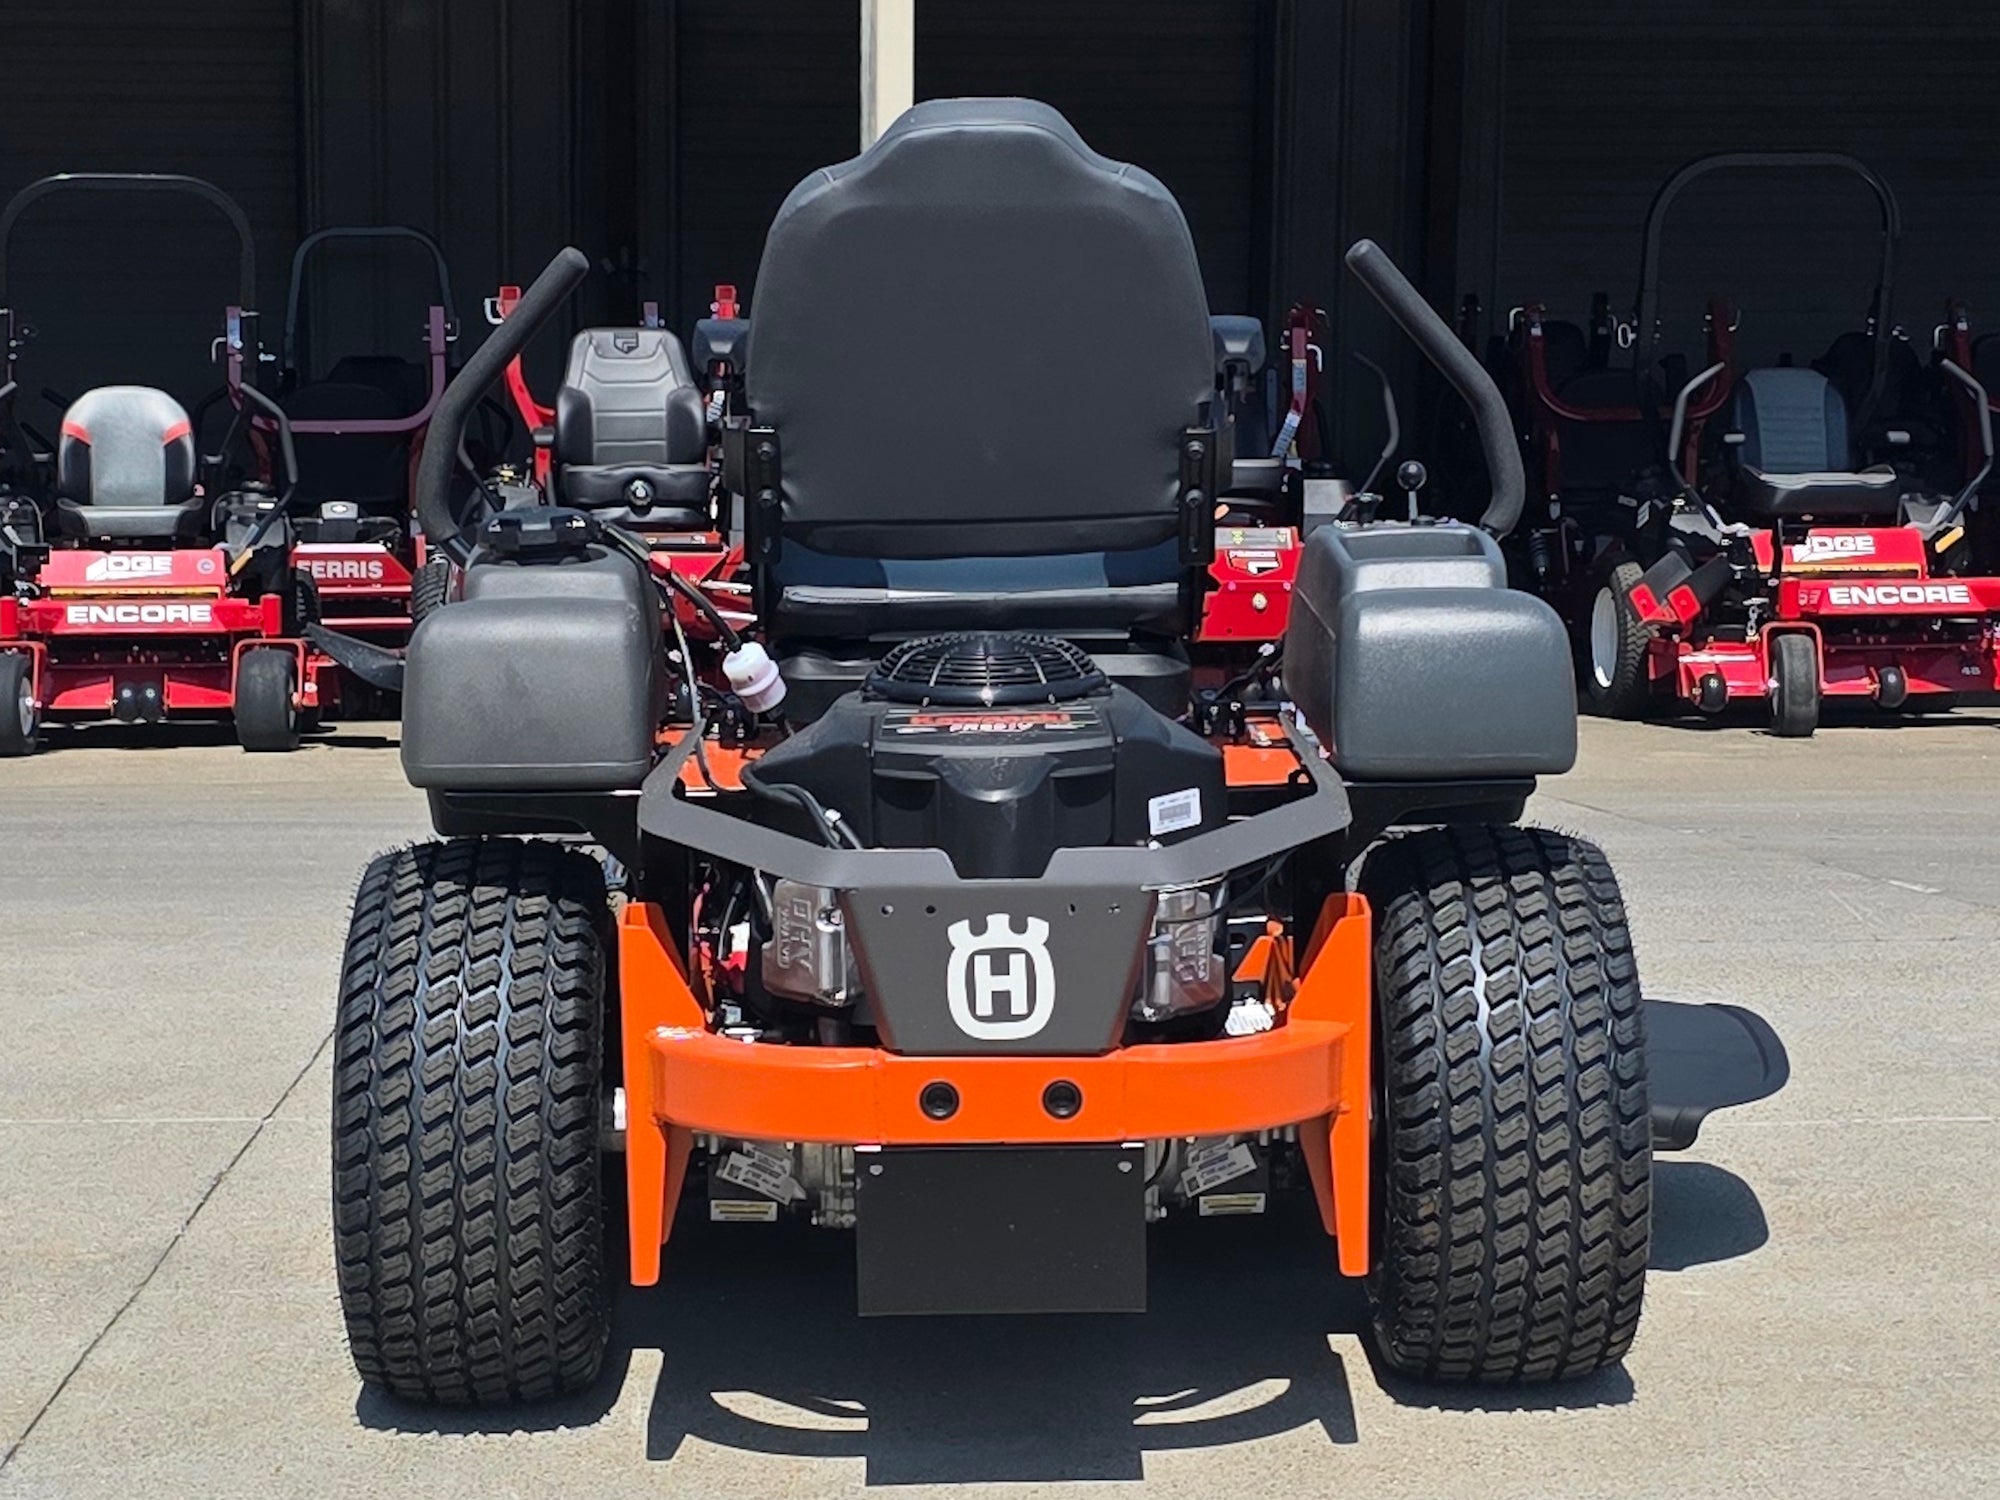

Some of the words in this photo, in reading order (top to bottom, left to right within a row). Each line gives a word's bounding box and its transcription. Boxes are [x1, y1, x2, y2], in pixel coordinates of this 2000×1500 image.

[1828, 585, 1970, 605] ENCORE
[67, 604, 212, 624] ENCORE
[974, 953, 1028, 1016] H
